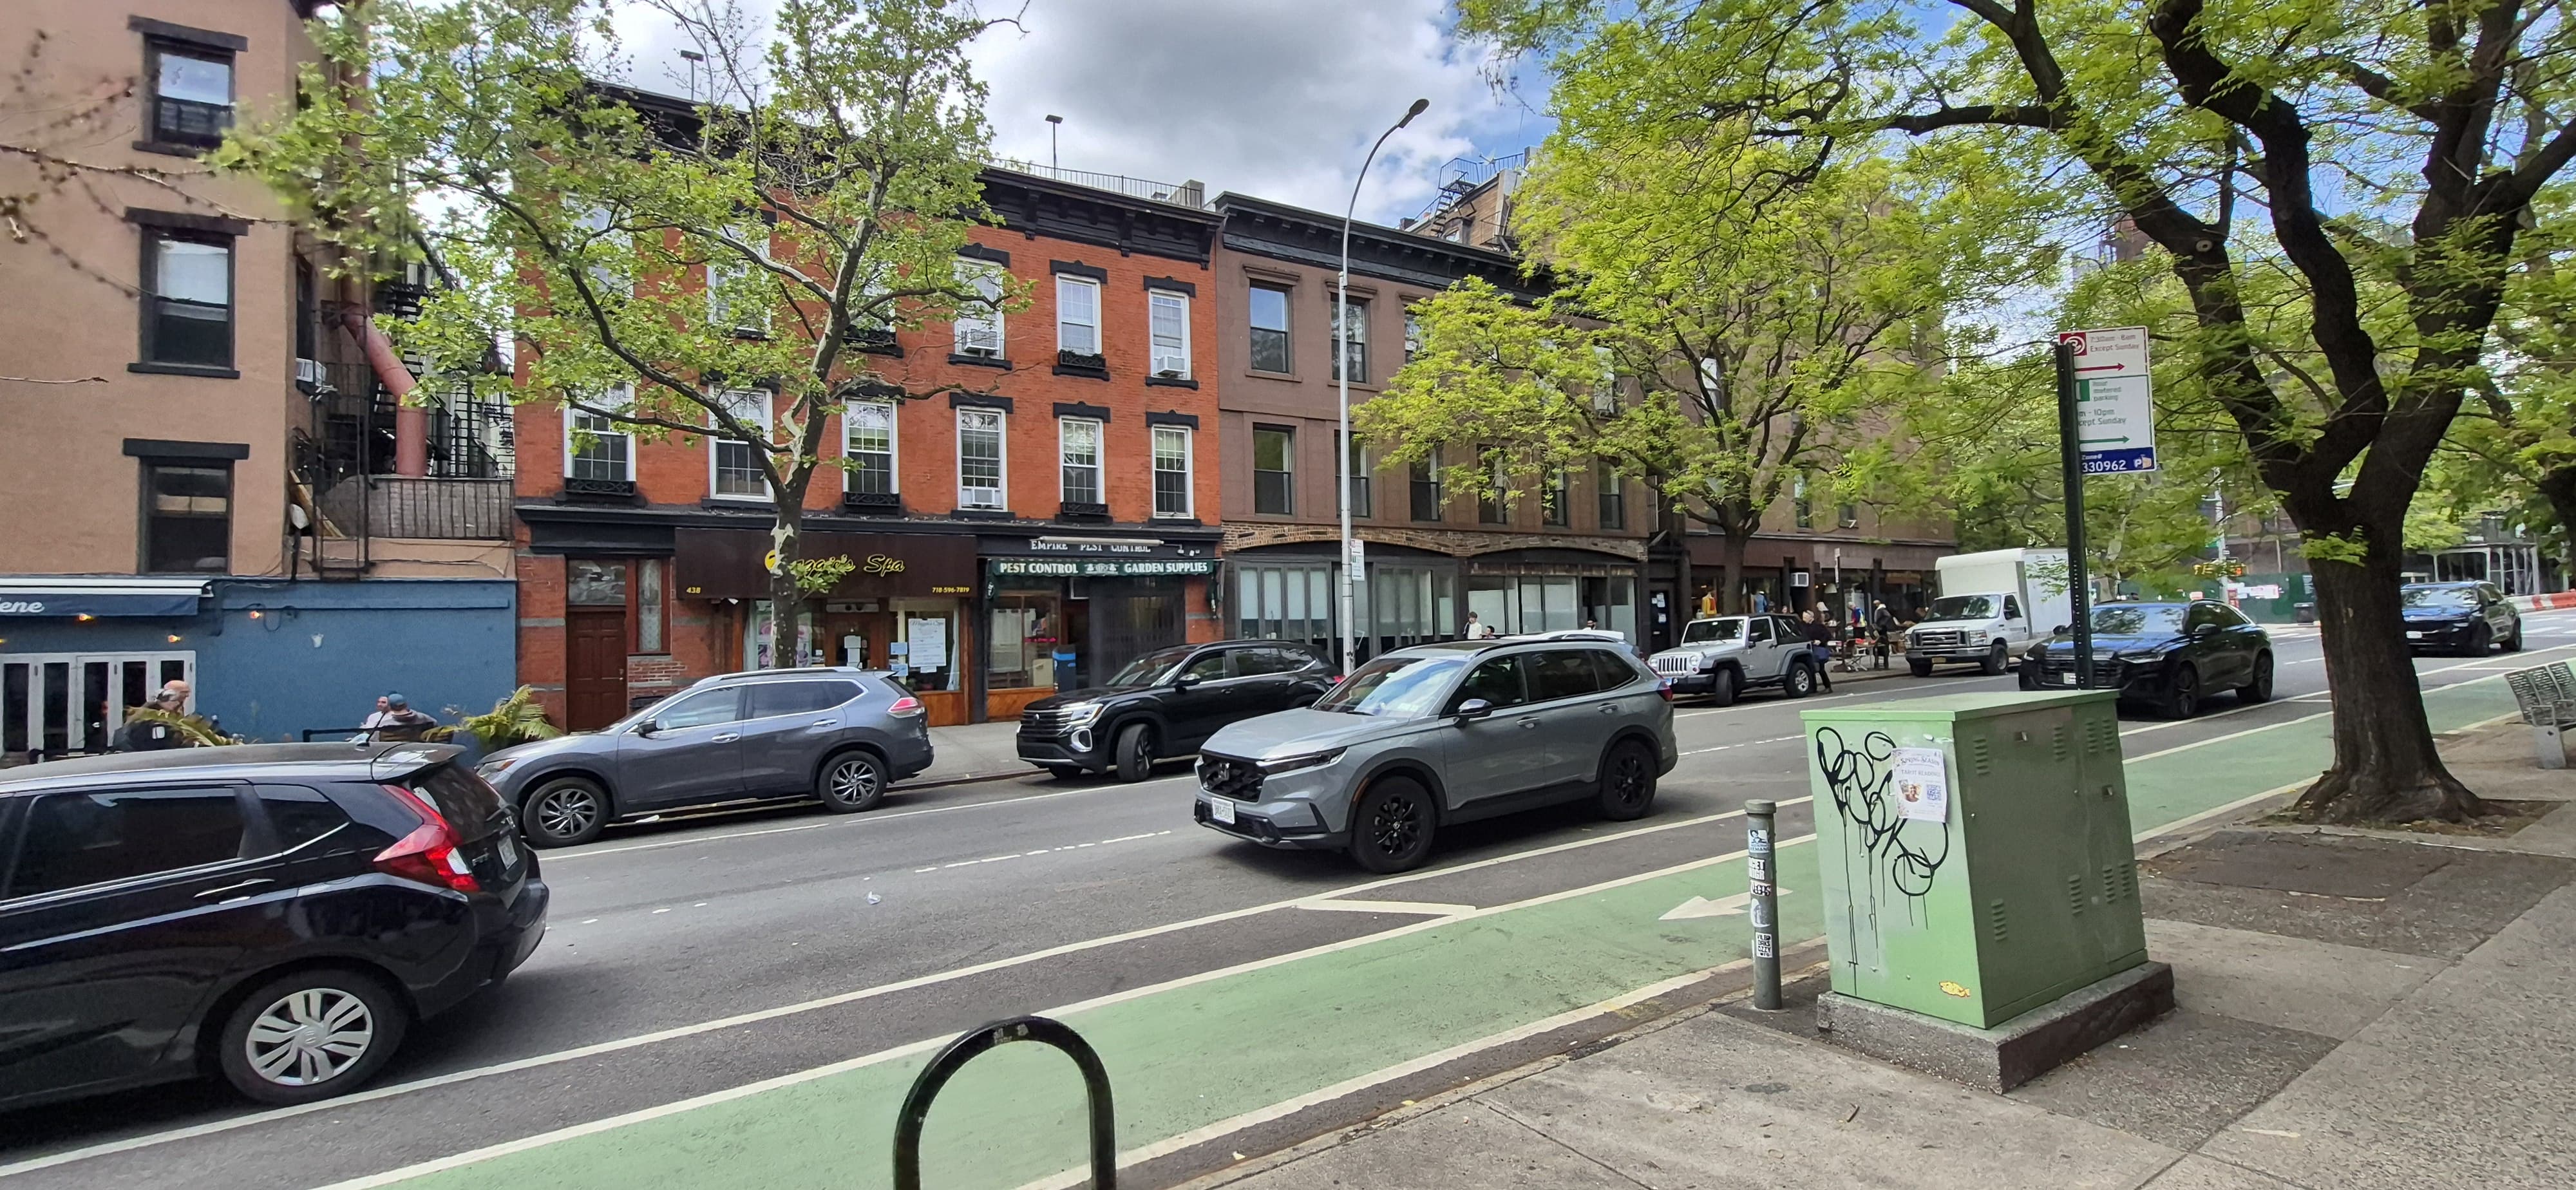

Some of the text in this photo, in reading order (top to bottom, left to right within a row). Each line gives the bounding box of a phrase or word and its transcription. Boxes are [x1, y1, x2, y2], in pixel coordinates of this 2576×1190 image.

[2115, 343, 2140, 351] Sunday
[2094, 408, 2115, 417] 10pm
[2078, 417, 2127, 427] cept Sunday
[2081, 459, 2127, 473] 330962
[1031, 540, 1068, 551] EMPIRE
[864, 554, 905, 578] Spa
[999, 562, 1079, 574] PEST CONTROL
[1124, 562, 1208, 574] GARDEN SUPPLIES
[0, 597, 45, 613] ene
